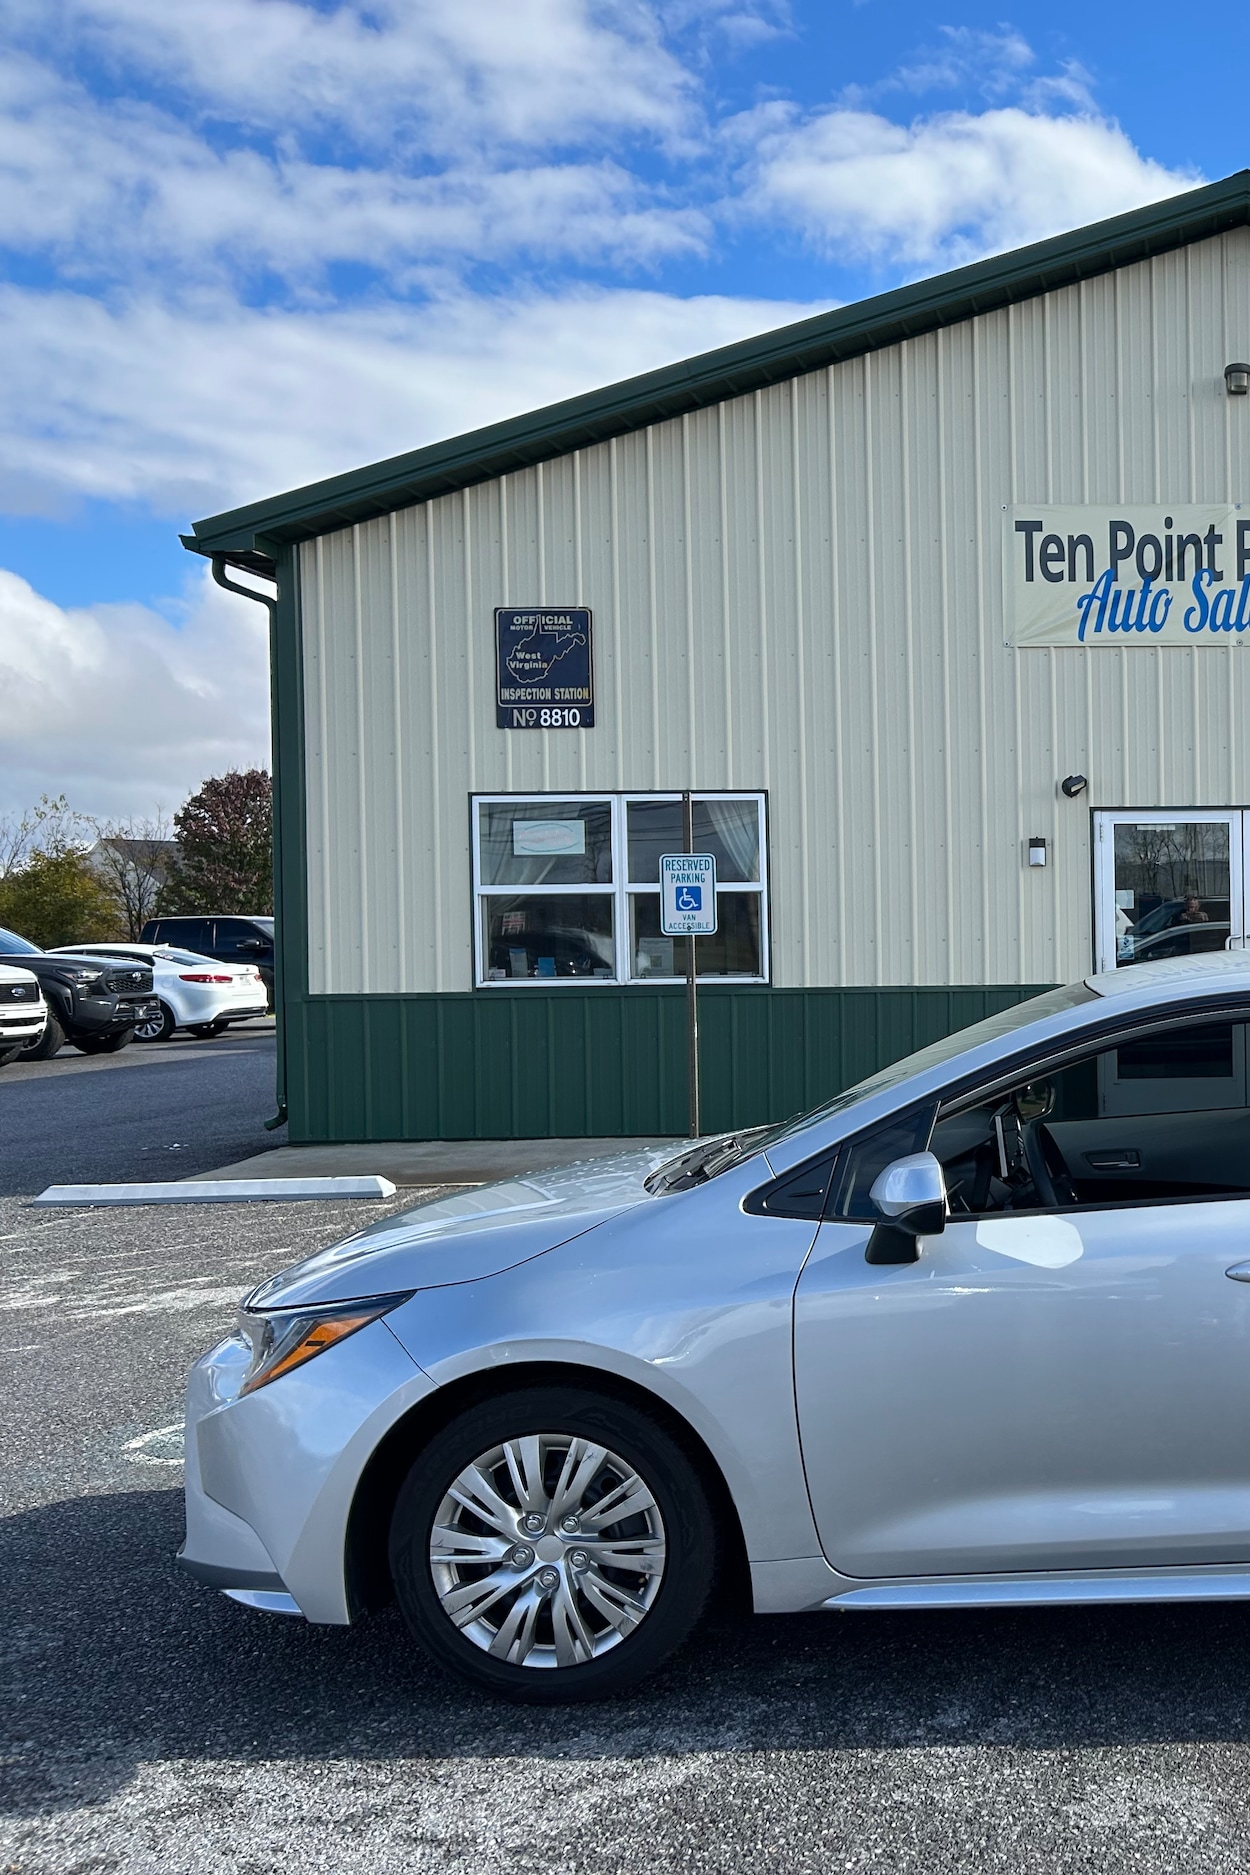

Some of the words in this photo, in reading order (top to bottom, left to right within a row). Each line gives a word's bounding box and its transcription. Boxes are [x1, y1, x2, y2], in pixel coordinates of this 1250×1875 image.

[1014, 519, 1095, 582] Ten
[1108, 516, 1224, 582] Point
[1076, 568, 1173, 642] Auto
[509, 661, 548, 670] Virginia
[501, 688, 551, 700] INSPECTION
[554, 688, 589, 700] STATION
[540, 708, 580, 727] 8810
[665, 859, 710, 871] RESERVED
[671, 873, 706, 883] PARKING
[668, 922, 710, 930] ACCESSIBLE
